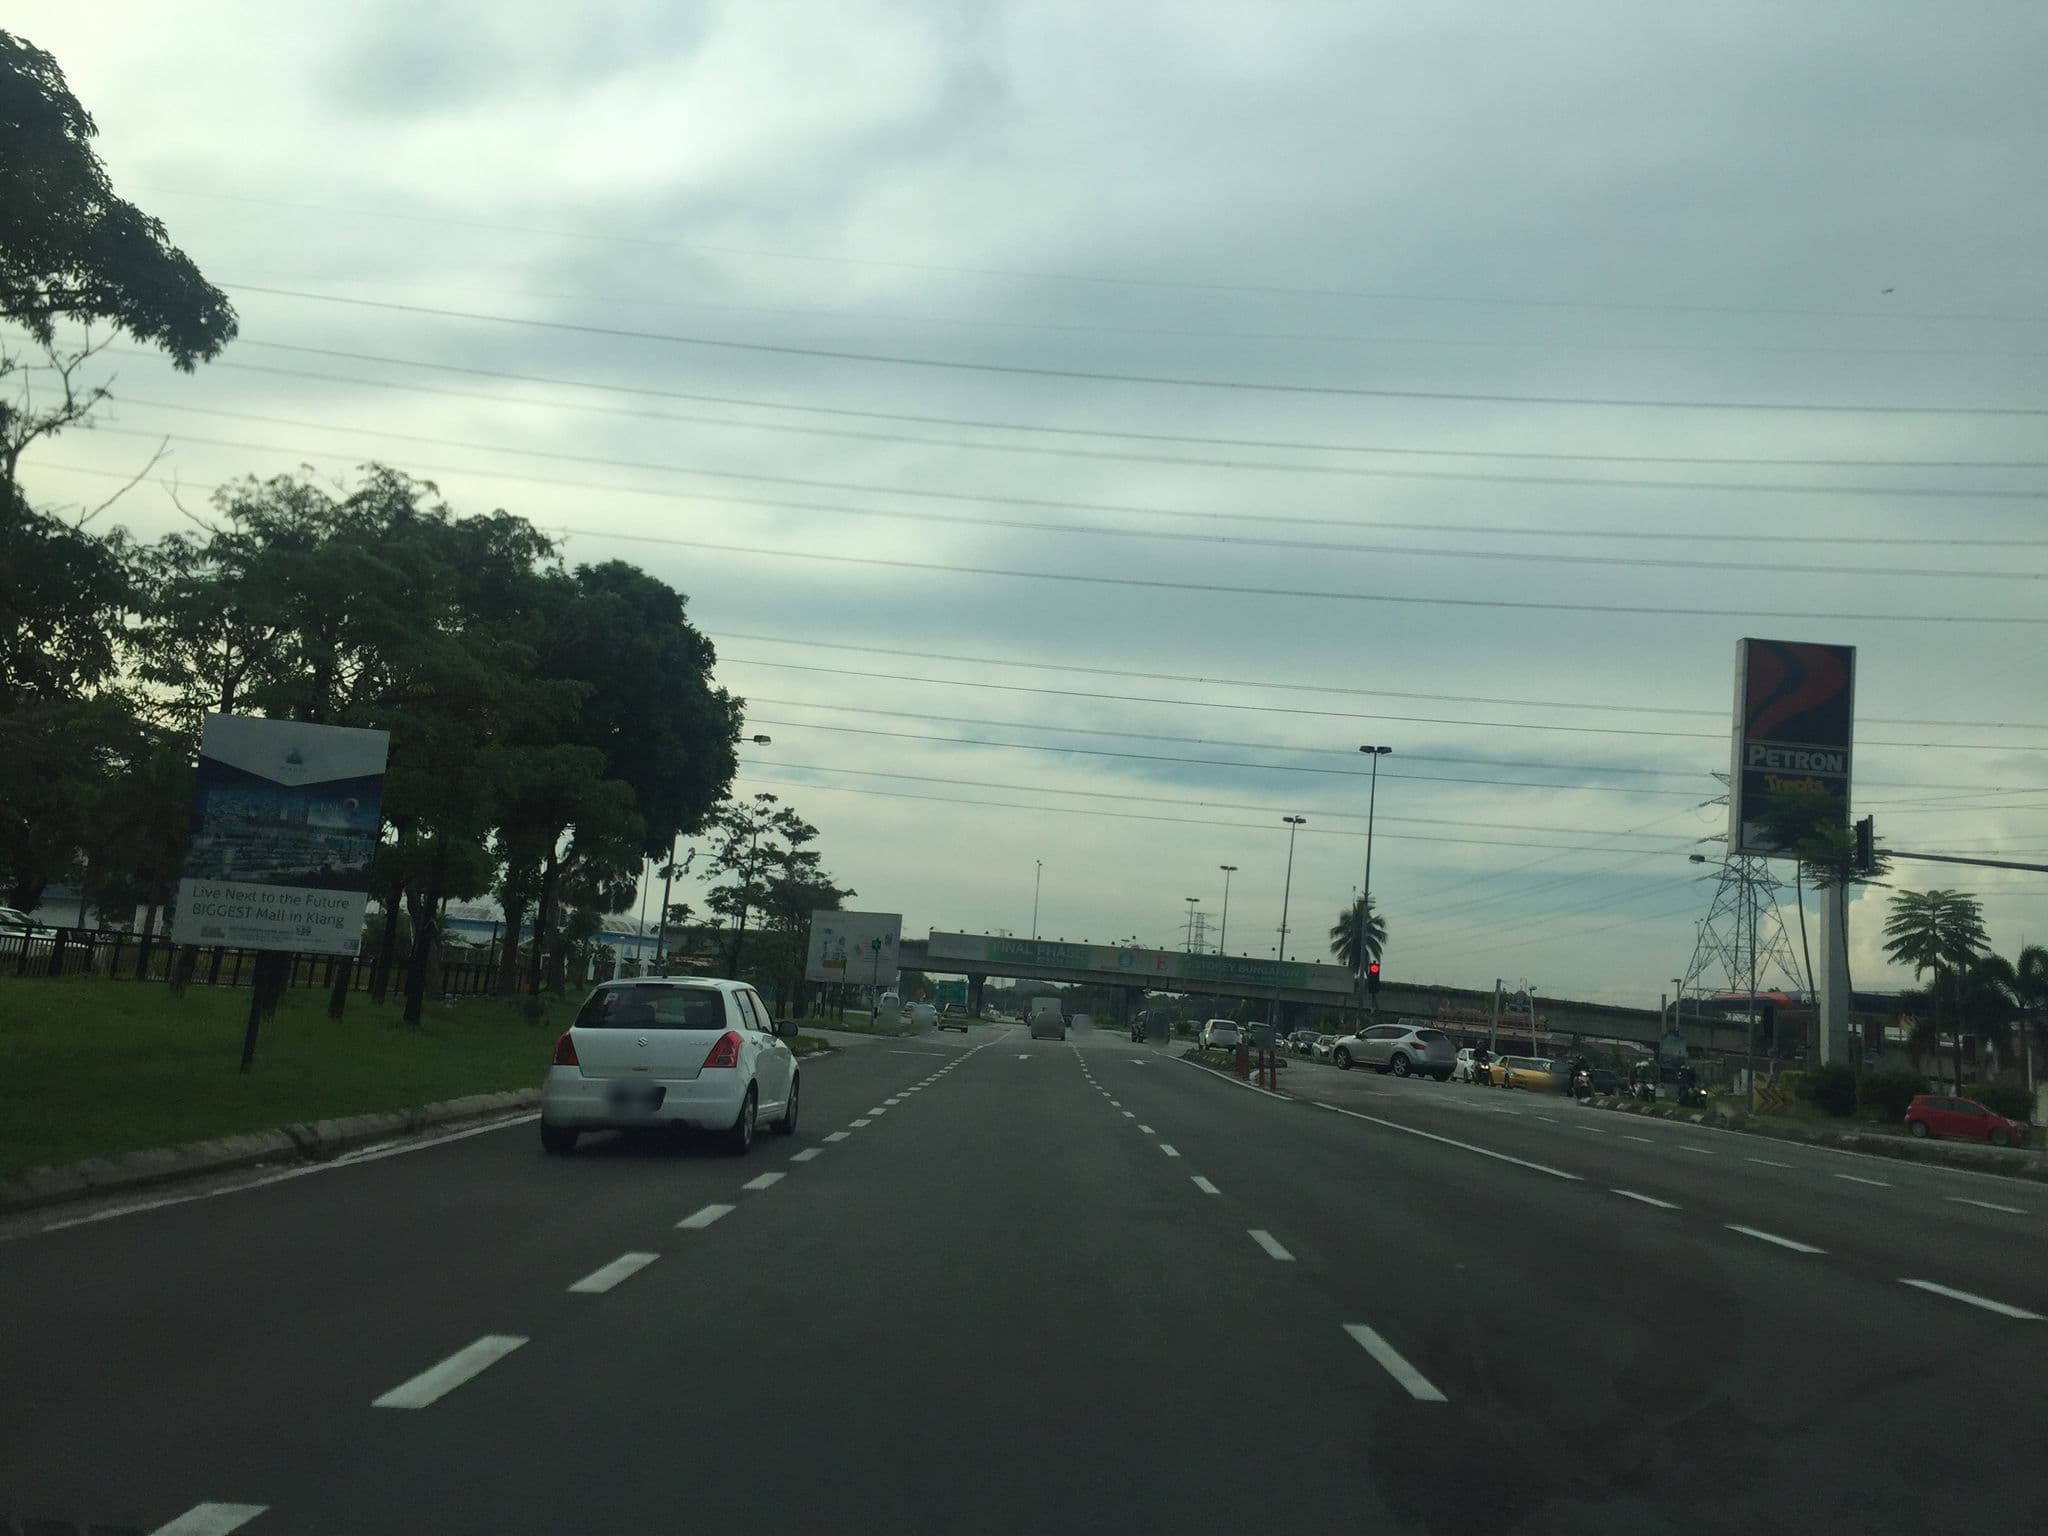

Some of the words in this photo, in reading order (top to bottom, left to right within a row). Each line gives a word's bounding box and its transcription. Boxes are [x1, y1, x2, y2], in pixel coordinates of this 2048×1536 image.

[1748, 745, 1842, 771] PETRON
[192, 885, 221, 899] Live
[225, 888, 256, 901] Next
[261, 890, 276, 903] to
[279, 891, 302, 905] the
[306, 894, 350, 910] Future
[192, 903, 252, 918] BIGGEST
[255, 907, 285, 922] Mall
[289, 911, 302, 923] in
[306, 911, 345, 929] Klang
